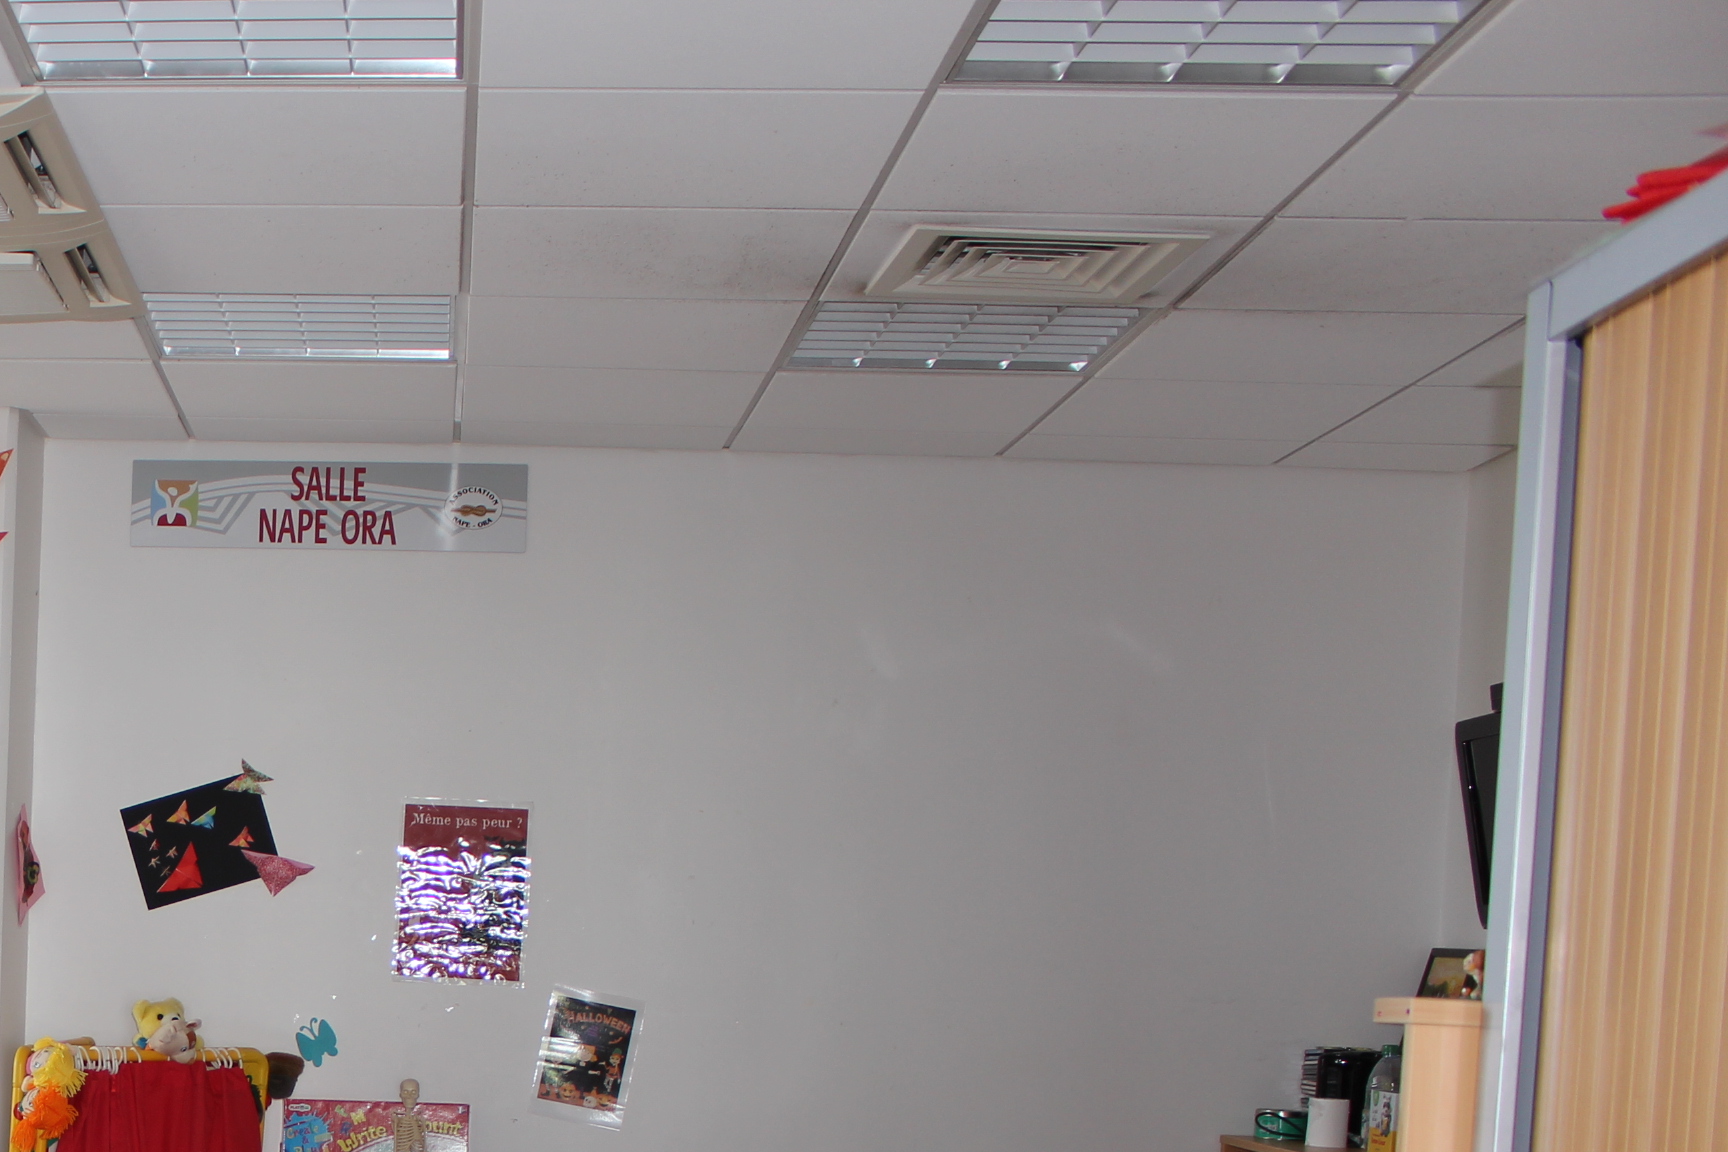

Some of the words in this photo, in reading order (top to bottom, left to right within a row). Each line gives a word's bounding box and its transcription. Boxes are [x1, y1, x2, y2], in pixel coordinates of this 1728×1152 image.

[290, 466, 367, 503] SALLE
[258, 508, 328, 544] NAPE
[340, 509, 397, 546] ORA
[409, 812, 451, 827] Même
[455, 817, 478, 829] pas
[482, 818, 512, 830] peur
[516, 817, 523, 829] ?
[564, 1009, 632, 1034] HALLOWEEN
[337, 1125, 387, 1152] Write
